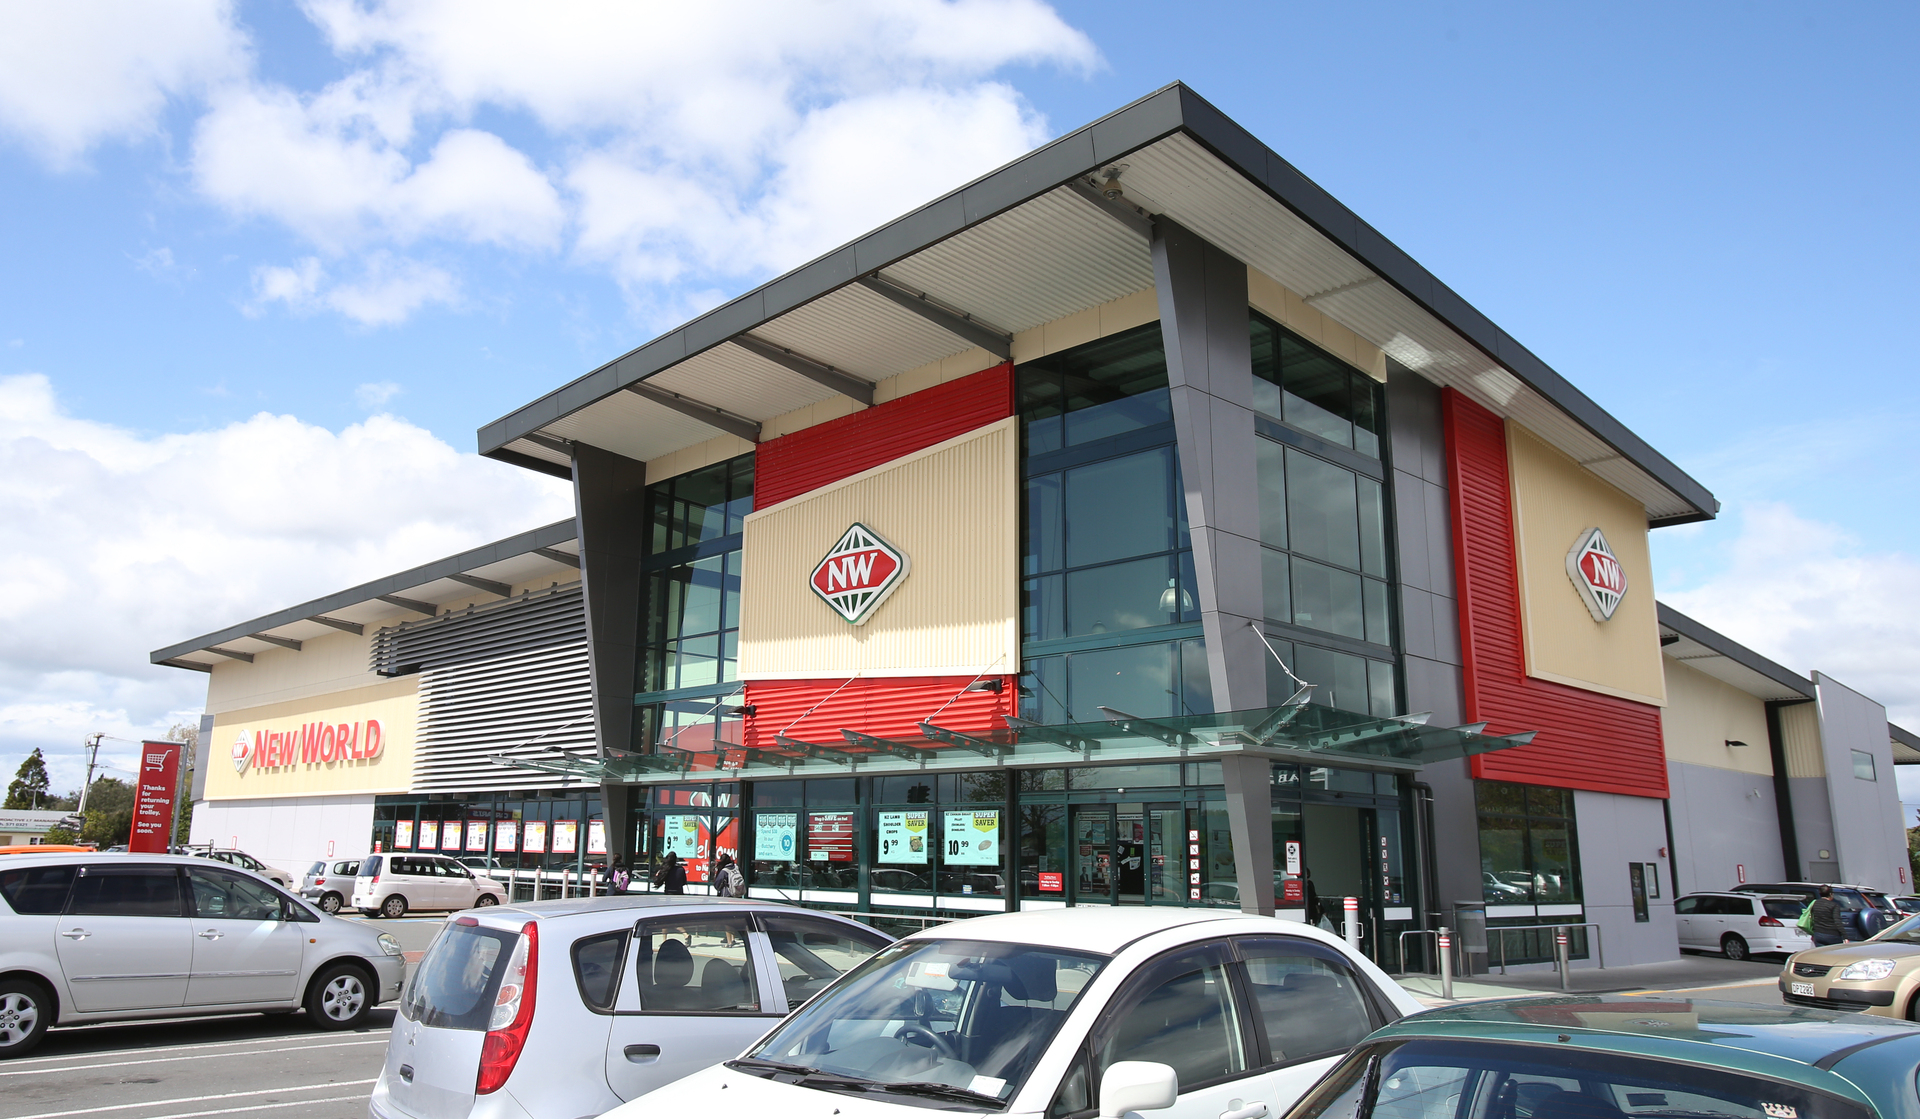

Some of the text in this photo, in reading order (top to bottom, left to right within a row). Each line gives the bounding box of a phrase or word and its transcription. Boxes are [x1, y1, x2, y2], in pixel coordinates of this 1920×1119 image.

[827, 552, 878, 592] NW
[1590, 553, 1620, 591] NW
[140, 797, 170, 805] returning
[783, 839, 790, 848] 10
[883, 839, 889, 855] 9
[948, 840, 959, 855] 10
